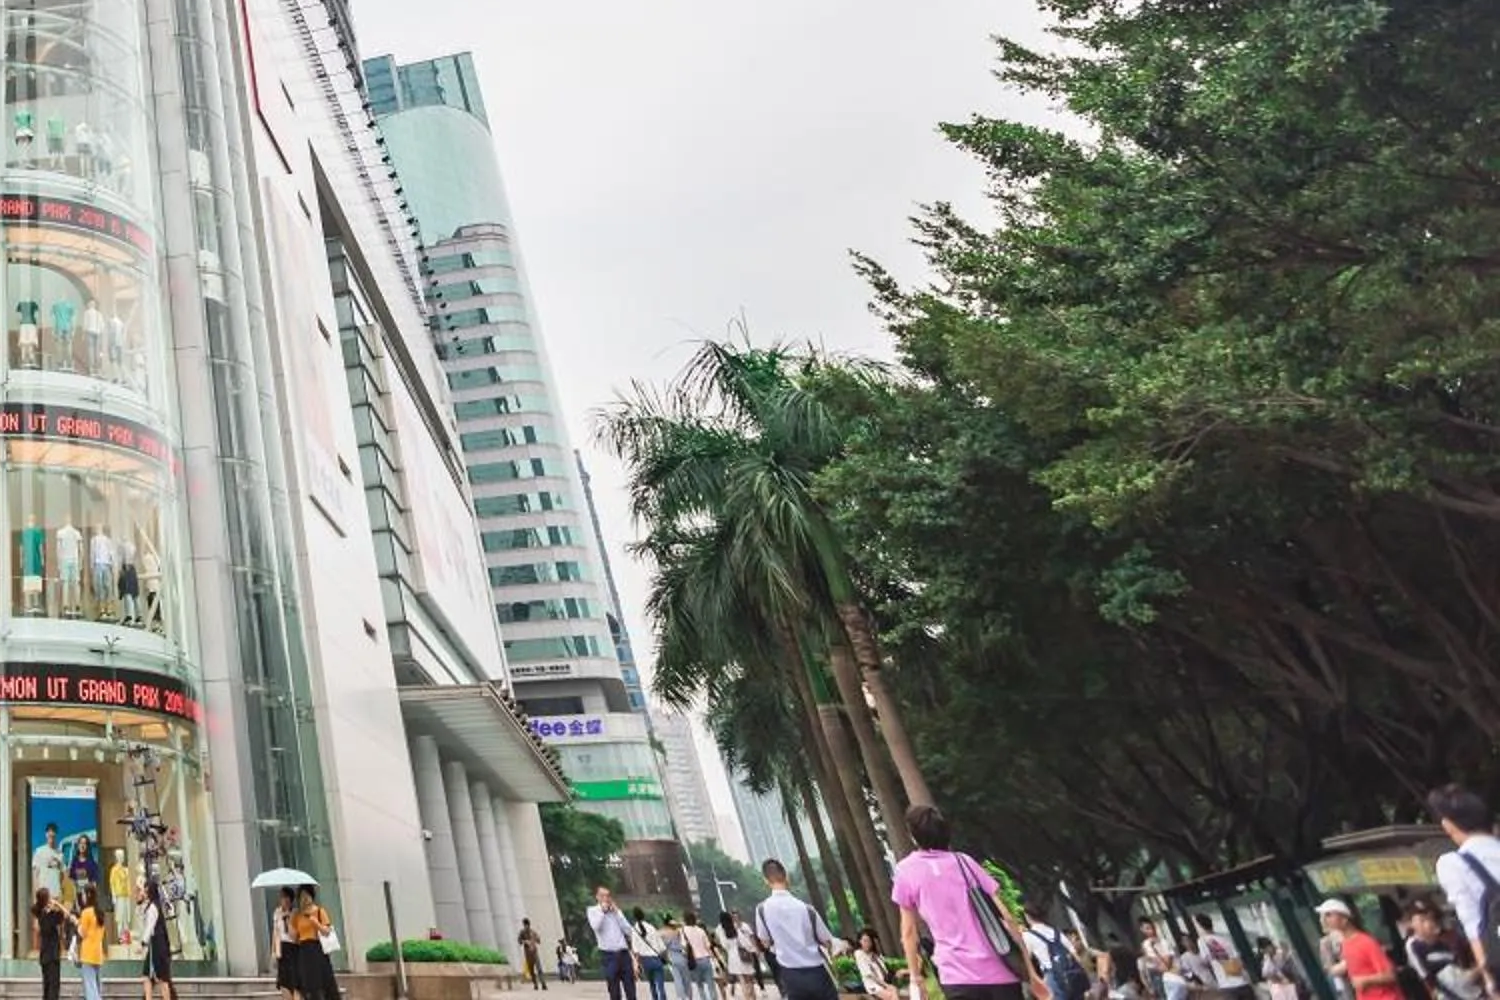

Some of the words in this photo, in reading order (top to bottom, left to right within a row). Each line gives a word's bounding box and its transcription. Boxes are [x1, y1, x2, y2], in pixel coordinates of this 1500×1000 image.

[28, 415, 48, 432] UT
[57, 416, 102, 438] GRAND
[48, 676, 69, 700] UT
[79, 679, 126, 704] GRAND
[133, 684, 160, 708] PRIX
